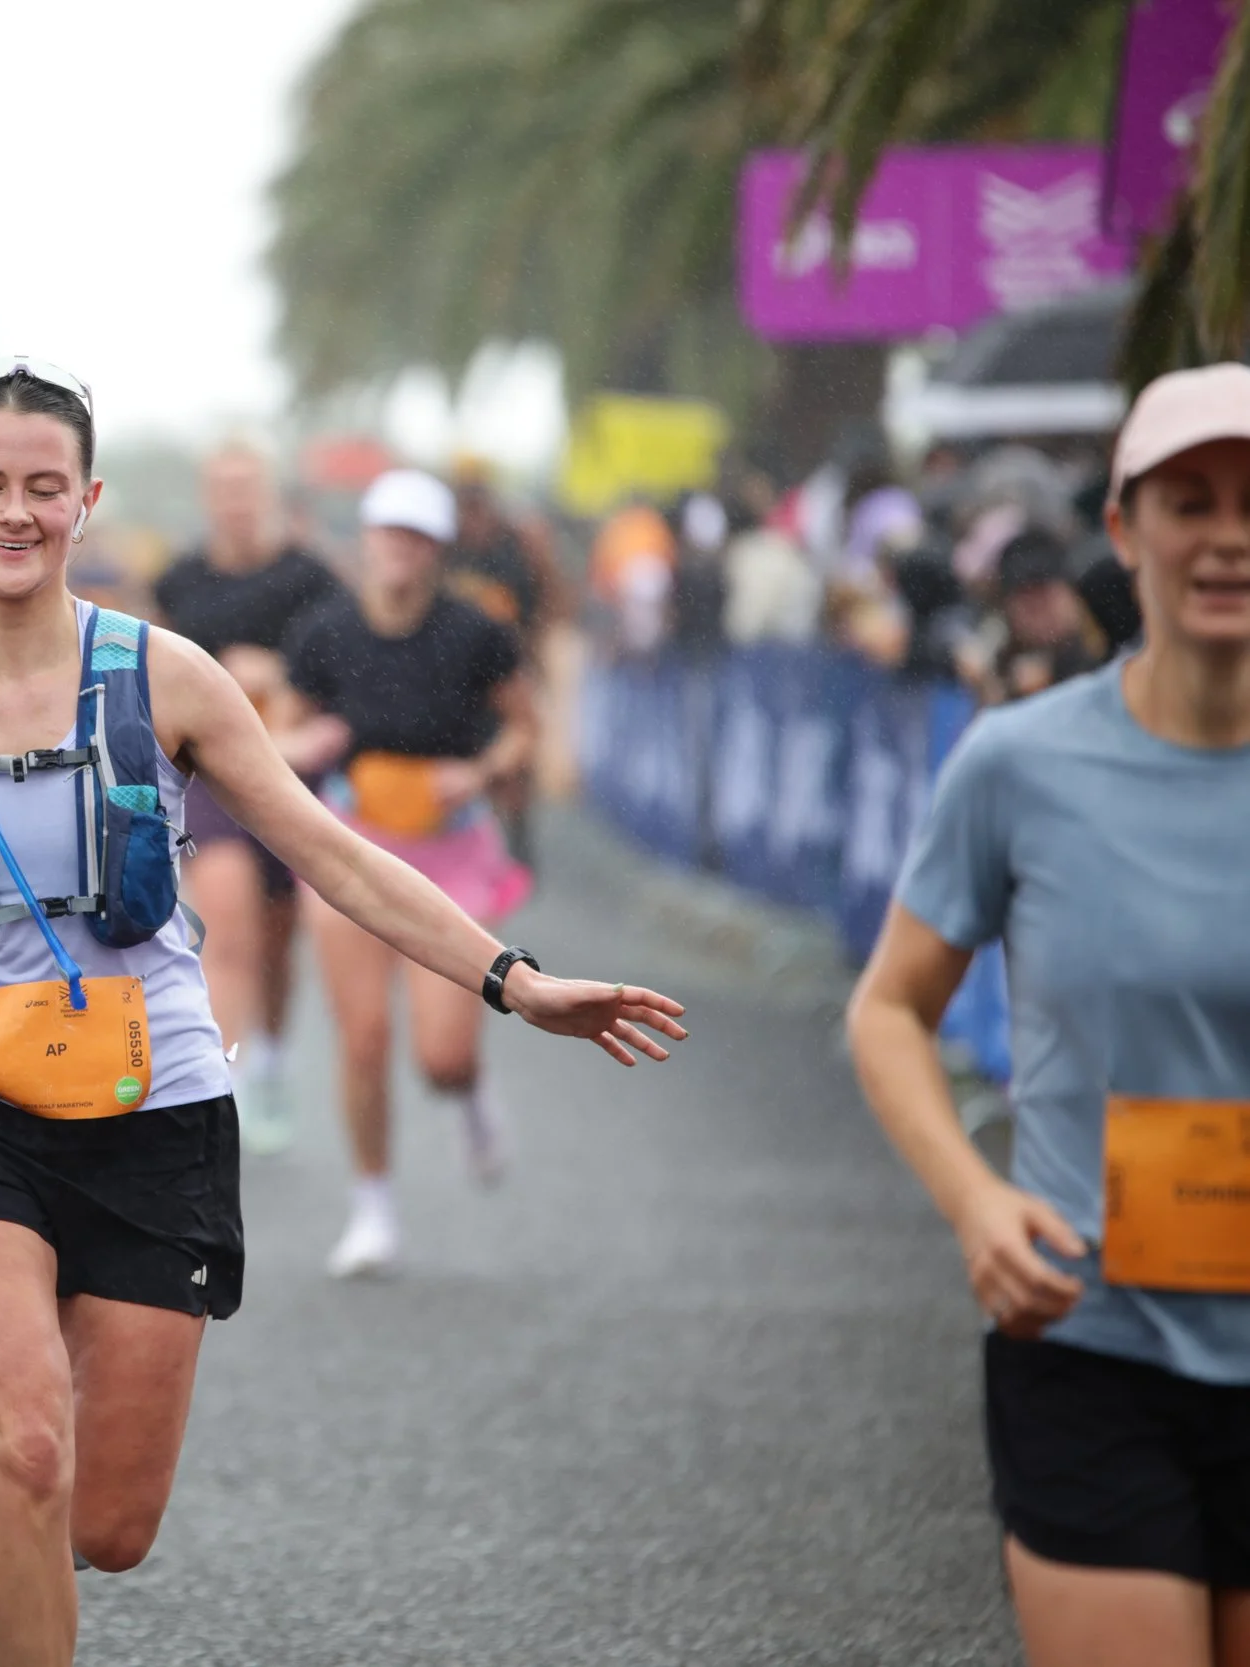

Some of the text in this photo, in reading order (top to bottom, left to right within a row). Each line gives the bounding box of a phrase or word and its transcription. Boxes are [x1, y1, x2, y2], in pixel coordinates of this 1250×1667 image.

[45, 1043, 67, 1057] AP
[128, 1020, 143, 1068] 05530
[117, 1085, 140, 1093] GREEN
